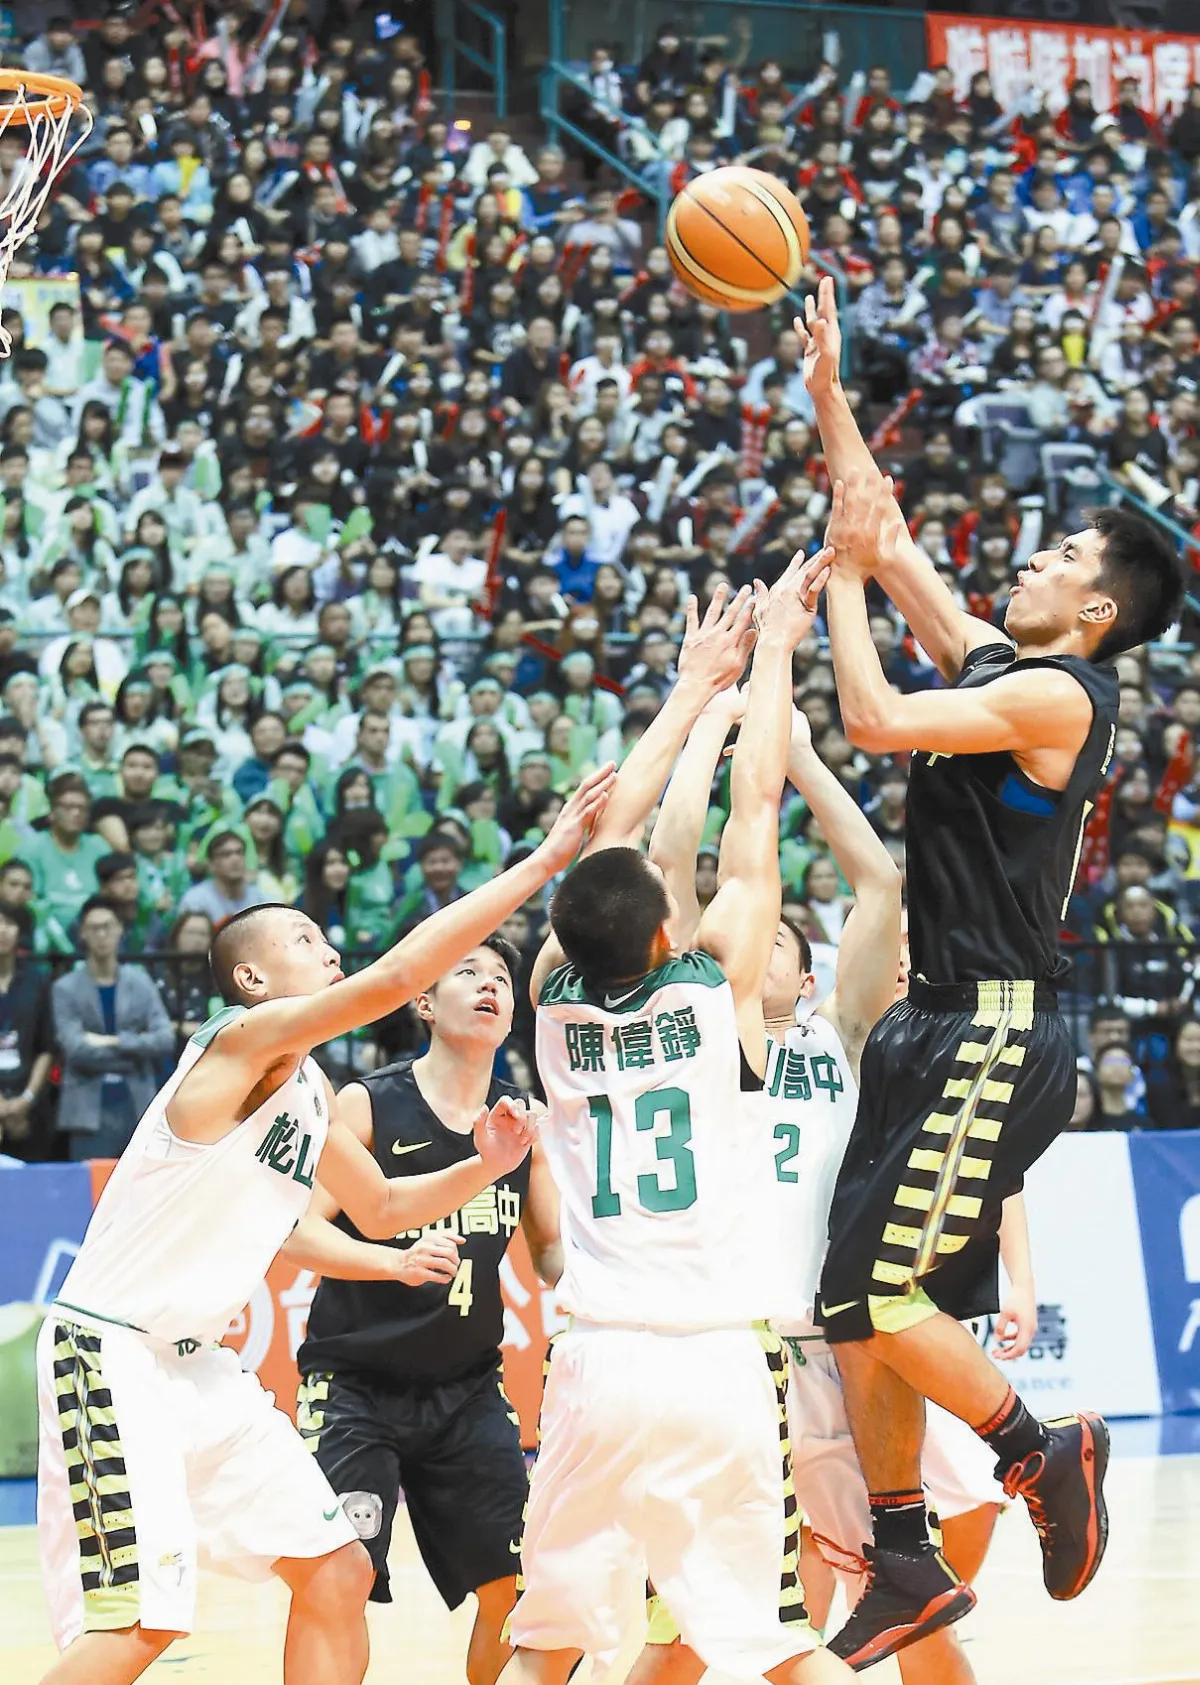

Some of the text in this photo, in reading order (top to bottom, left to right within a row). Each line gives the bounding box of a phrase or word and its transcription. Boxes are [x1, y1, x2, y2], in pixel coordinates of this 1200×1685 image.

[565, 1006, 702, 1072] 陳偉錚
[586, 1086, 698, 1219] 13
[773, 1123, 801, 1184] 2
[448, 1258, 474, 1317] 4
